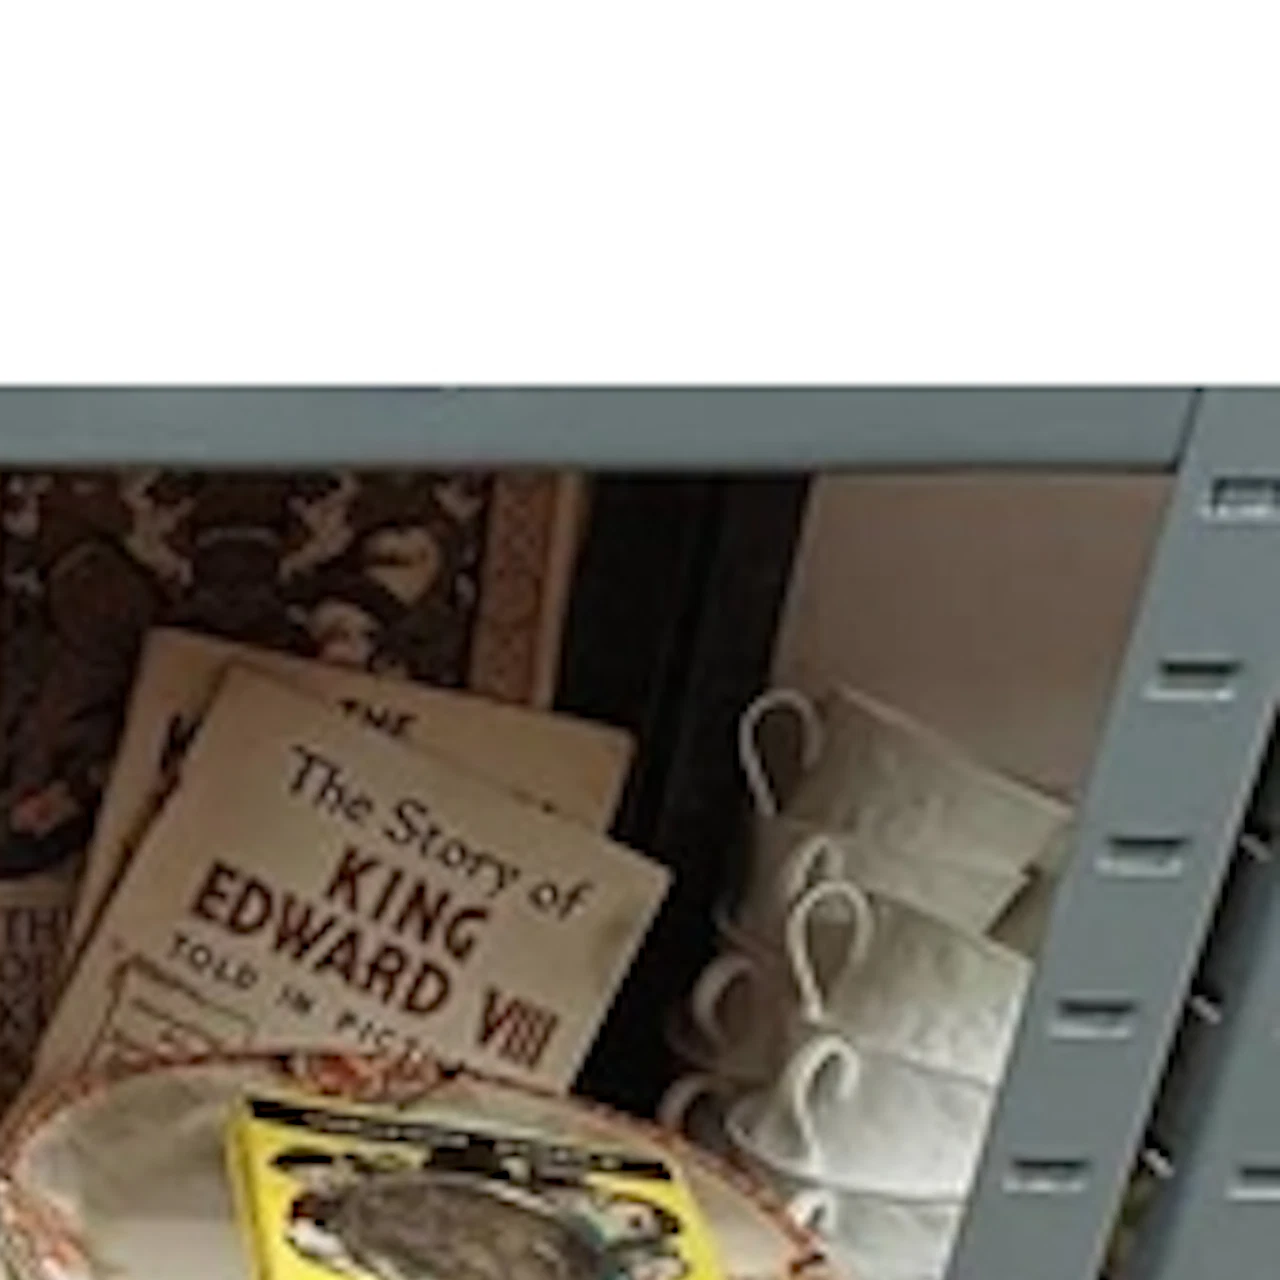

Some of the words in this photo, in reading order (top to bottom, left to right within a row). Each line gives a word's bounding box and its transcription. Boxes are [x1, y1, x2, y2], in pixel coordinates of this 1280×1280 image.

[290, 744, 373, 828] The
[384, 798, 522, 898] Story
[531, 880, 593, 922] of
[167, 930, 261, 992] TOLD
[189, 860, 454, 1019] EDWARD
[322, 845, 491, 966] KING
